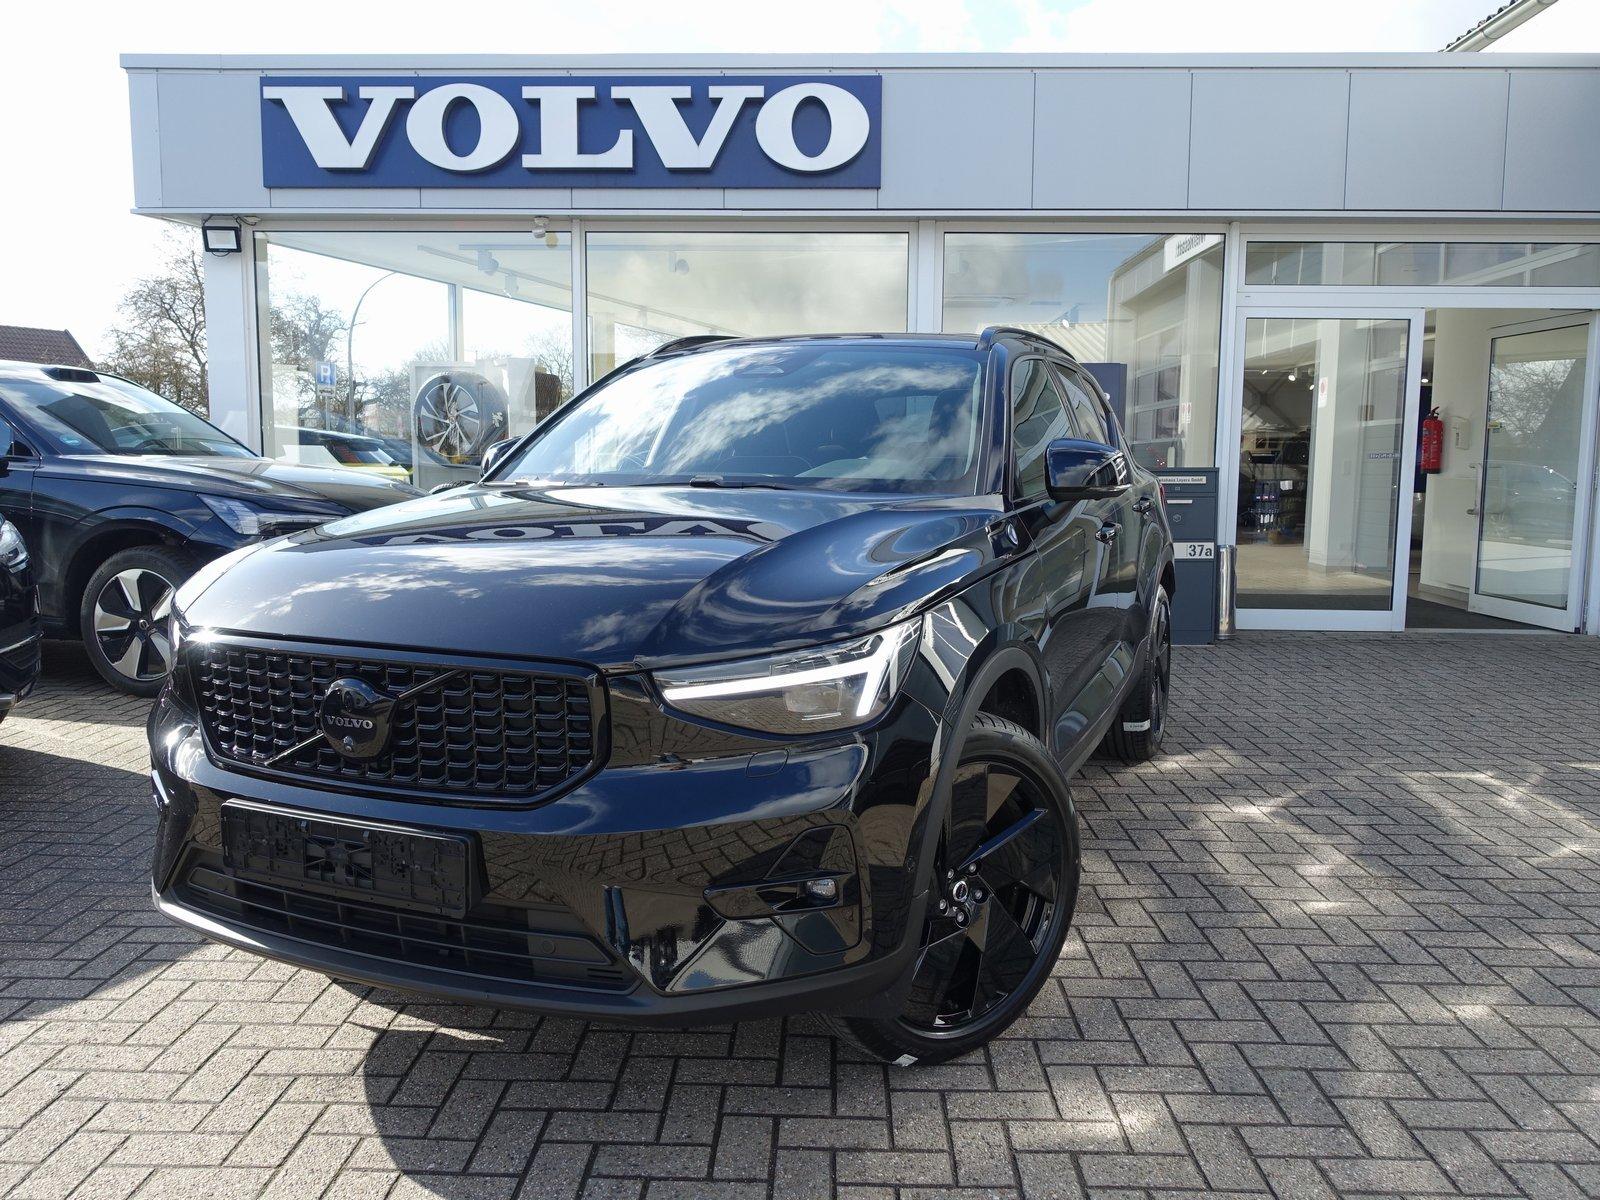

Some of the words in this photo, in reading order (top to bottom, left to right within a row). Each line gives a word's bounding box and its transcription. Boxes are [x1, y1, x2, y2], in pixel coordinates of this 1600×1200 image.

[262, 83, 870, 172] VOLVO
[1189, 544, 1212, 556] 37a
[325, 715, 373, 729] VOLVO
